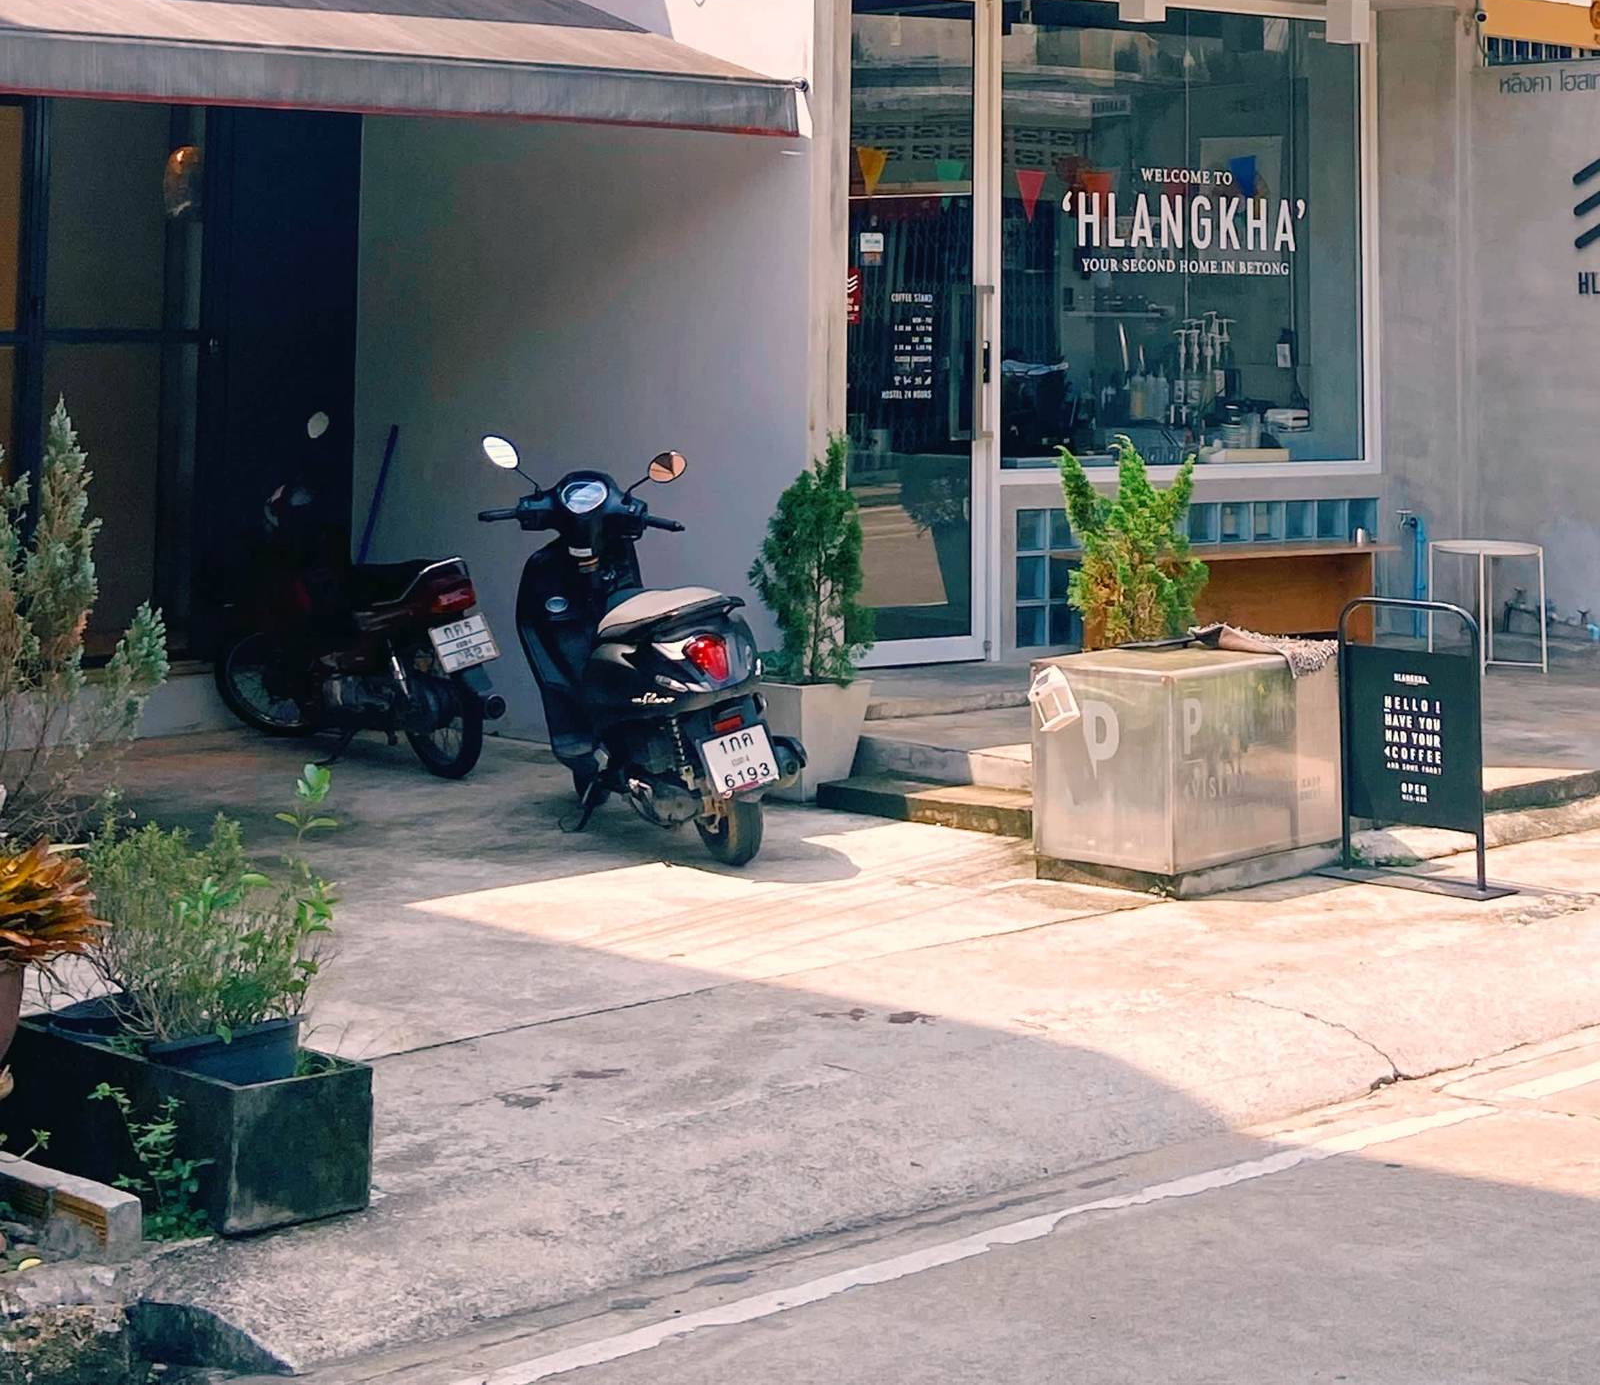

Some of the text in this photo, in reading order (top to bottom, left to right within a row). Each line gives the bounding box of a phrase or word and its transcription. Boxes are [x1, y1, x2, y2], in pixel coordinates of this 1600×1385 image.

[1141, 168, 1233, 185] WELCOME TO
[1082, 258, 1289, 275] YOUR SECOND HOME IN BETONG
[1384, 695, 1429, 713] HELLO
[1384, 713, 1441, 731] HAVE YOU
[1385, 729, 1441, 748] HAD YOUR
[1391, 746, 1441, 764] COFFEE
[724, 762, 770, 788] 6193
[1401, 782, 1427, 796] OPEN
